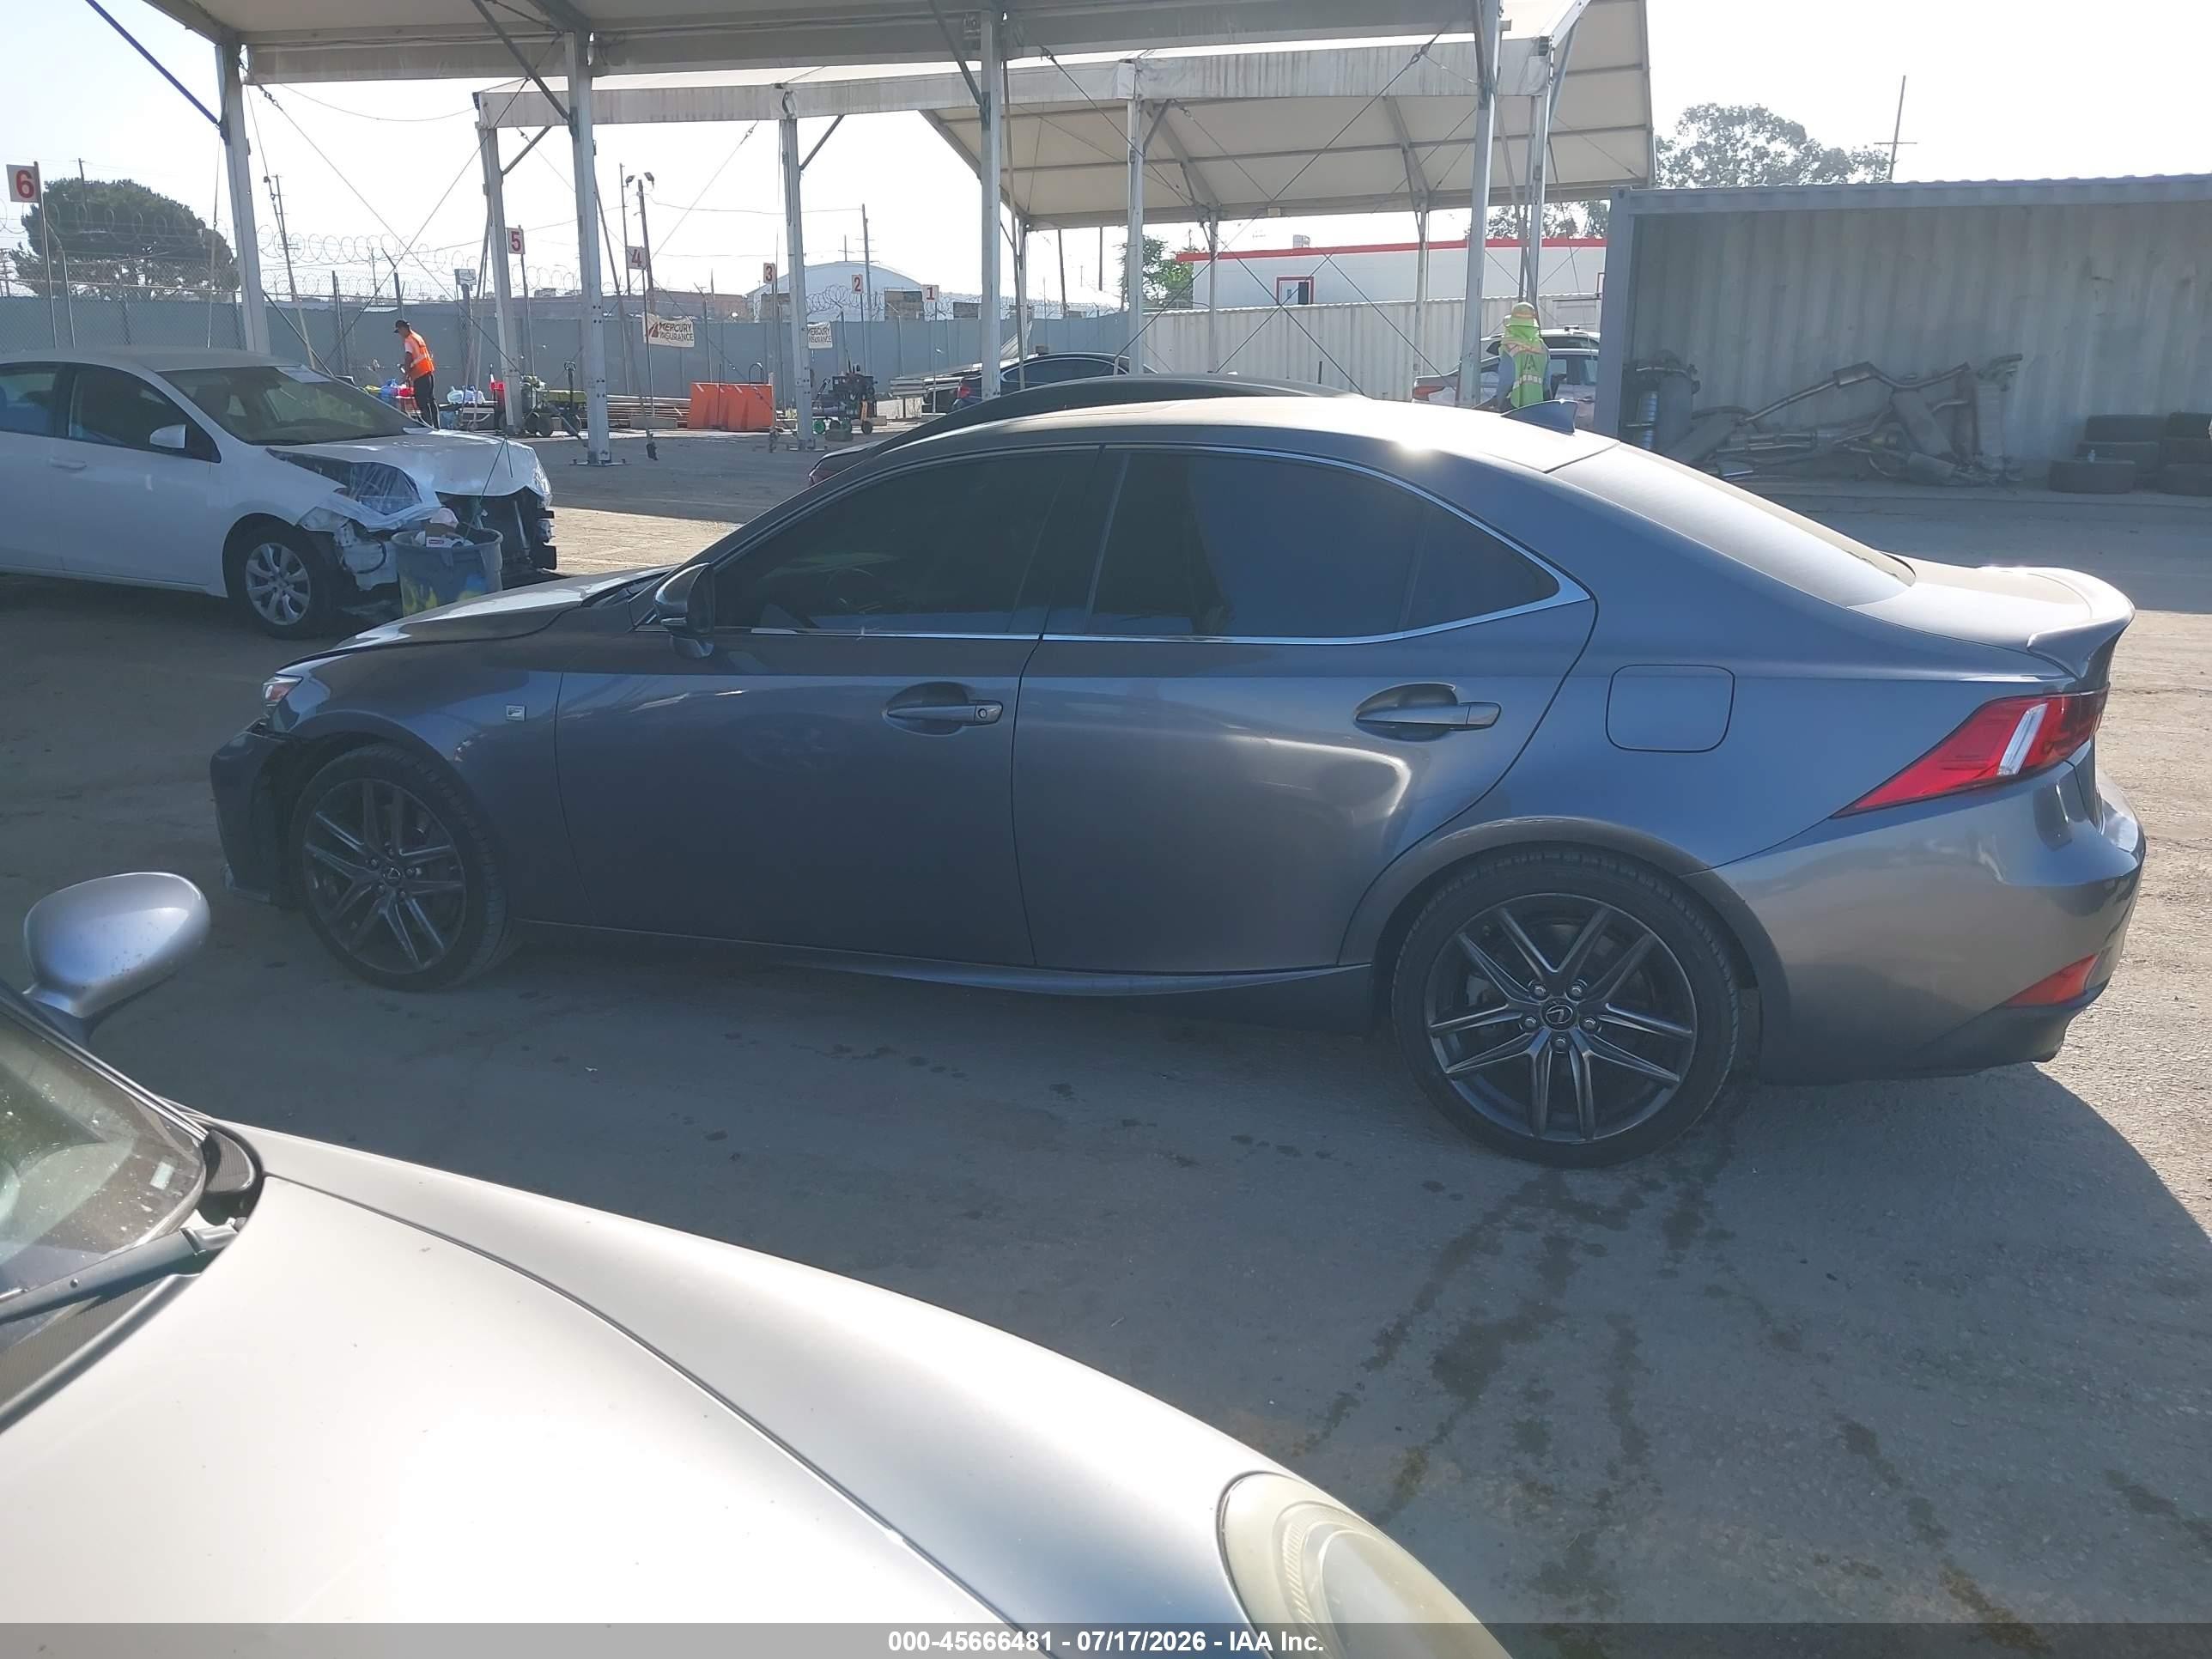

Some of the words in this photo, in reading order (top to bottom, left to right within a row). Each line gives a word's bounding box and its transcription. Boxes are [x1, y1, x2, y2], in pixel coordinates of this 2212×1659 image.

[15, 169, 35, 198] 6
[511, 231, 522, 252] 5
[631, 248, 643, 268] 4
[764, 265, 774, 282] 3
[854, 276, 862, 293] 2
[926, 286, 936, 301] 1
[659, 321, 692, 333] MERCURY
[659, 331, 694, 342] INSURANCE
[808, 335, 832, 343] NSURANCE
